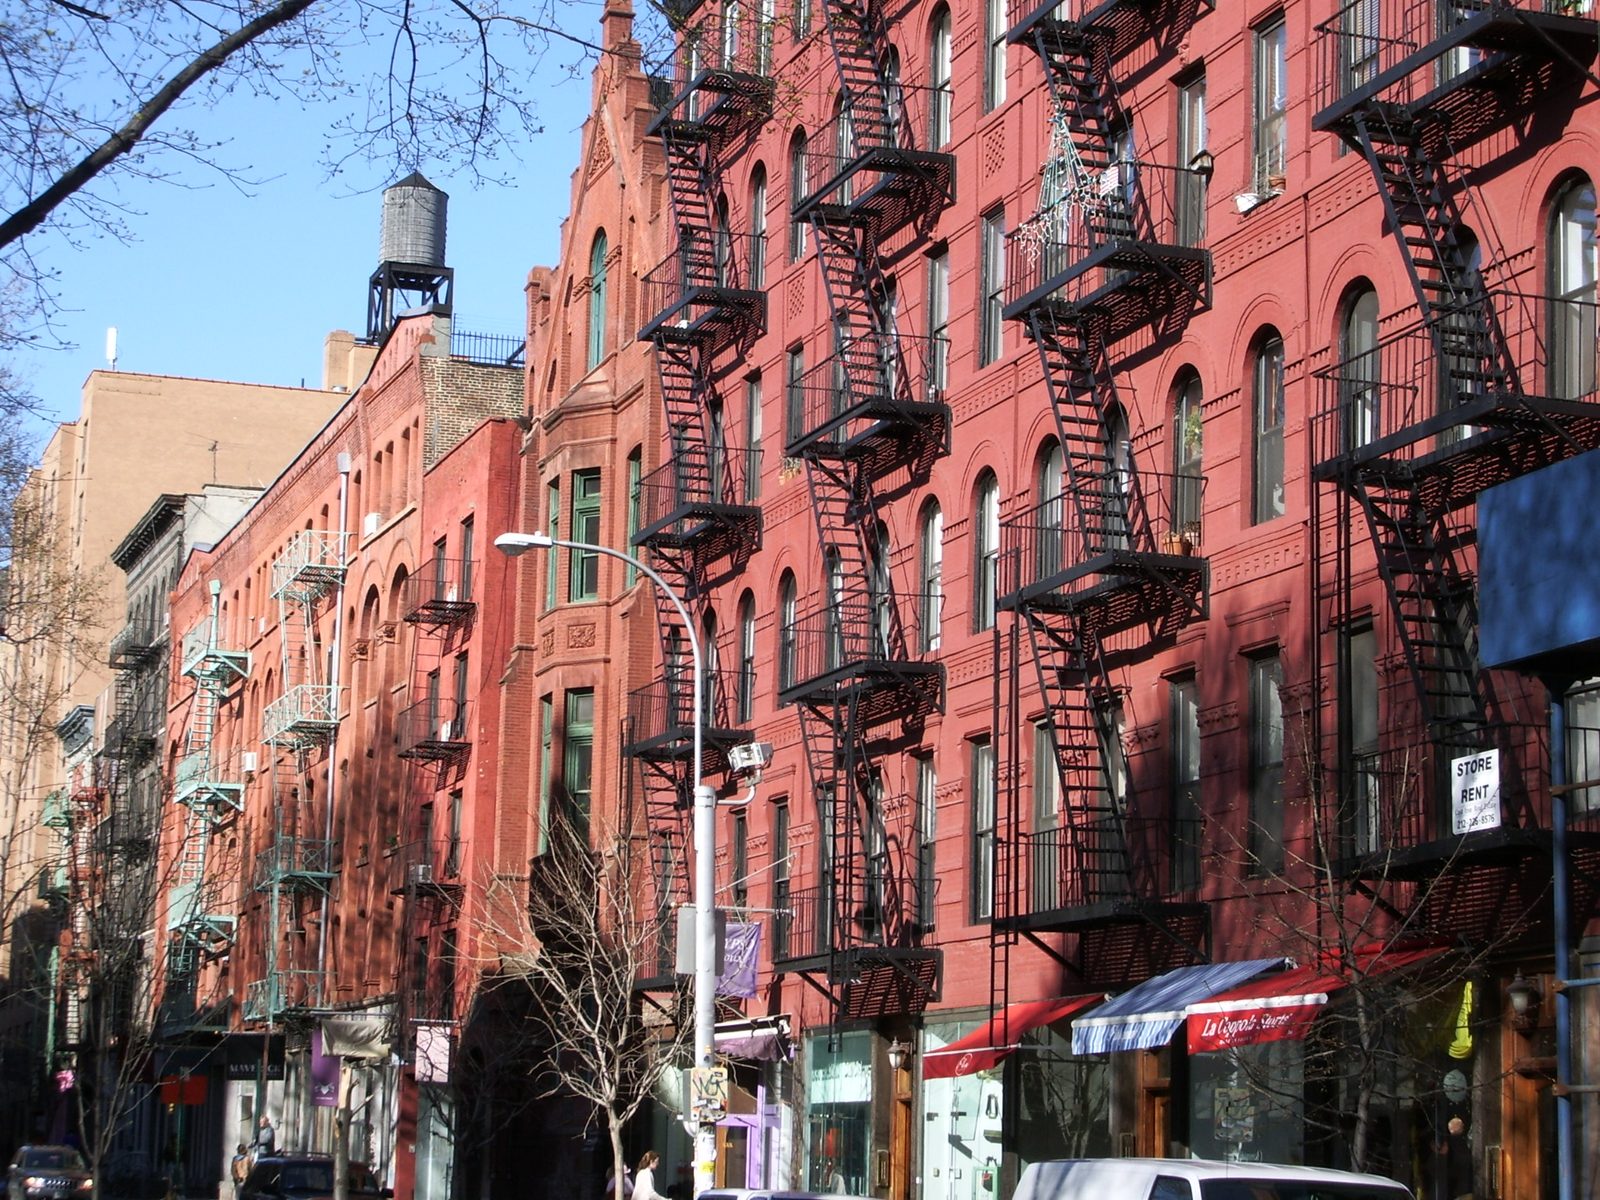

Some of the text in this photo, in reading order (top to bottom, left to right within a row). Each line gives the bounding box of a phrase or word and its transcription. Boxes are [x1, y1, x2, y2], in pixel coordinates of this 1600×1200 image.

[1457, 757, 1492, 777] STORE
[1461, 784, 1489, 803] RENT
[1202, 1018, 1217, 1037] La
